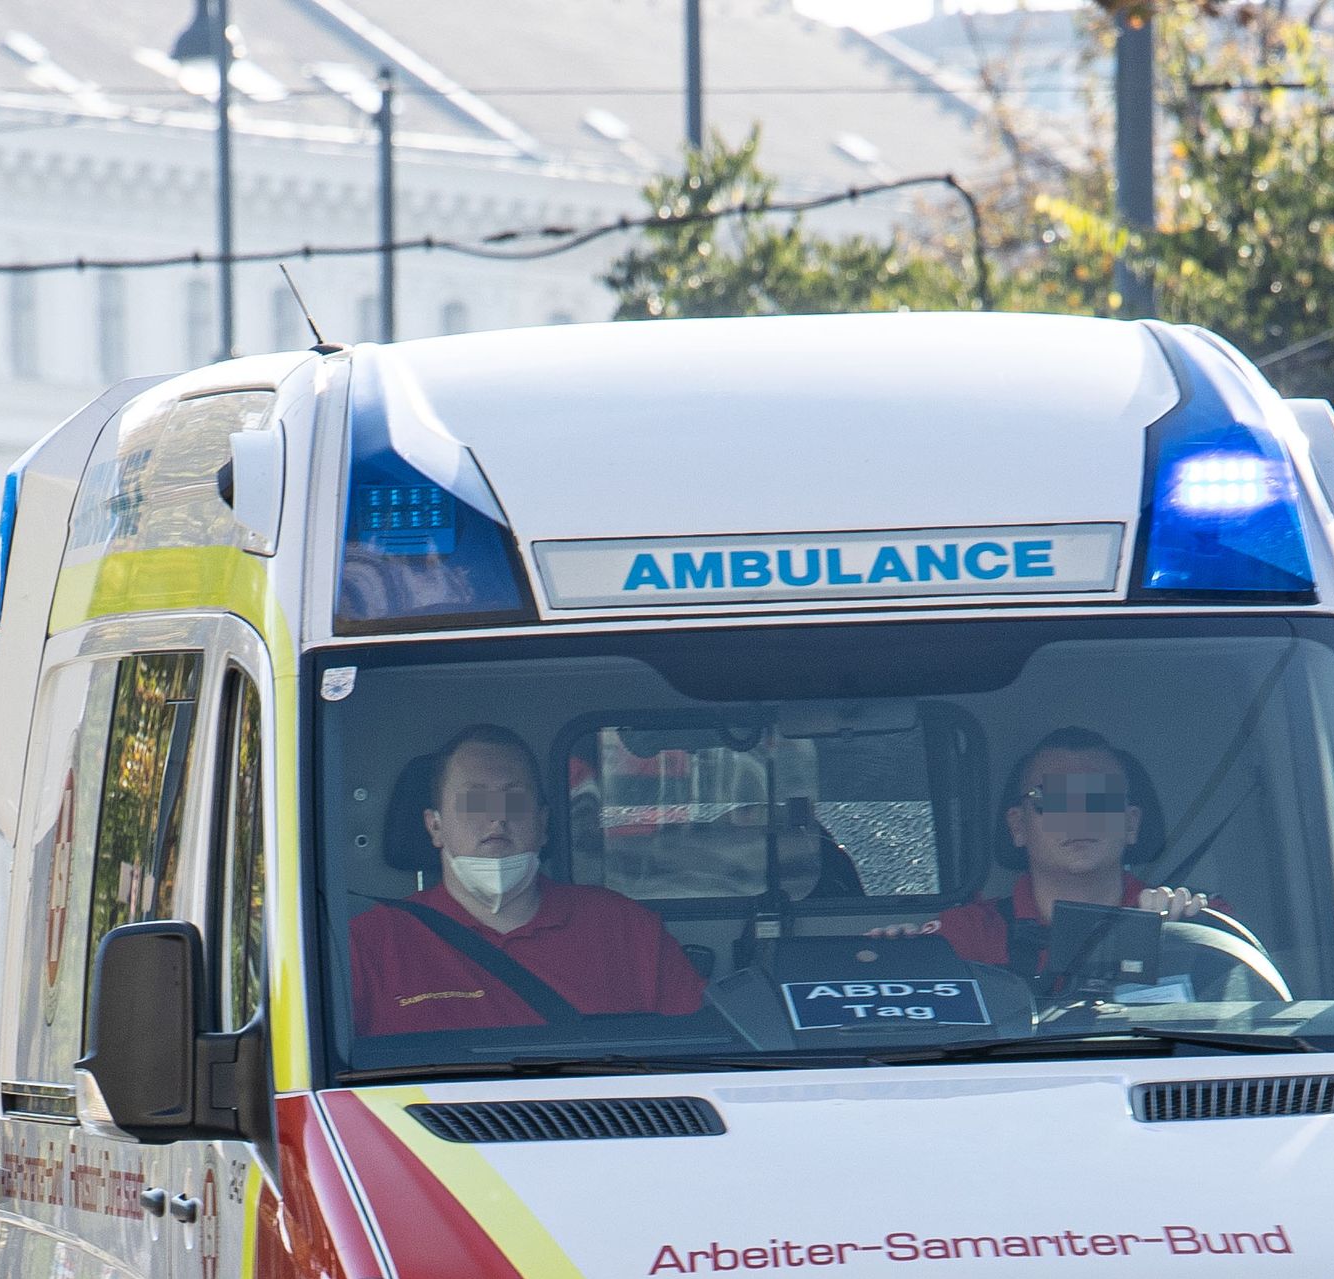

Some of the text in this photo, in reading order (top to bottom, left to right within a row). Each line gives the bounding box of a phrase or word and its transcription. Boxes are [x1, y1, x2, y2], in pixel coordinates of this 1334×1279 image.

[622, 540, 1055, 591] AMBULANCE
[806, 983, 962, 1000] ABD-5
[842, 1003, 936, 1020] Tag
[647, 1224, 1295, 1276] Arbeiter-Samariter-Bund
